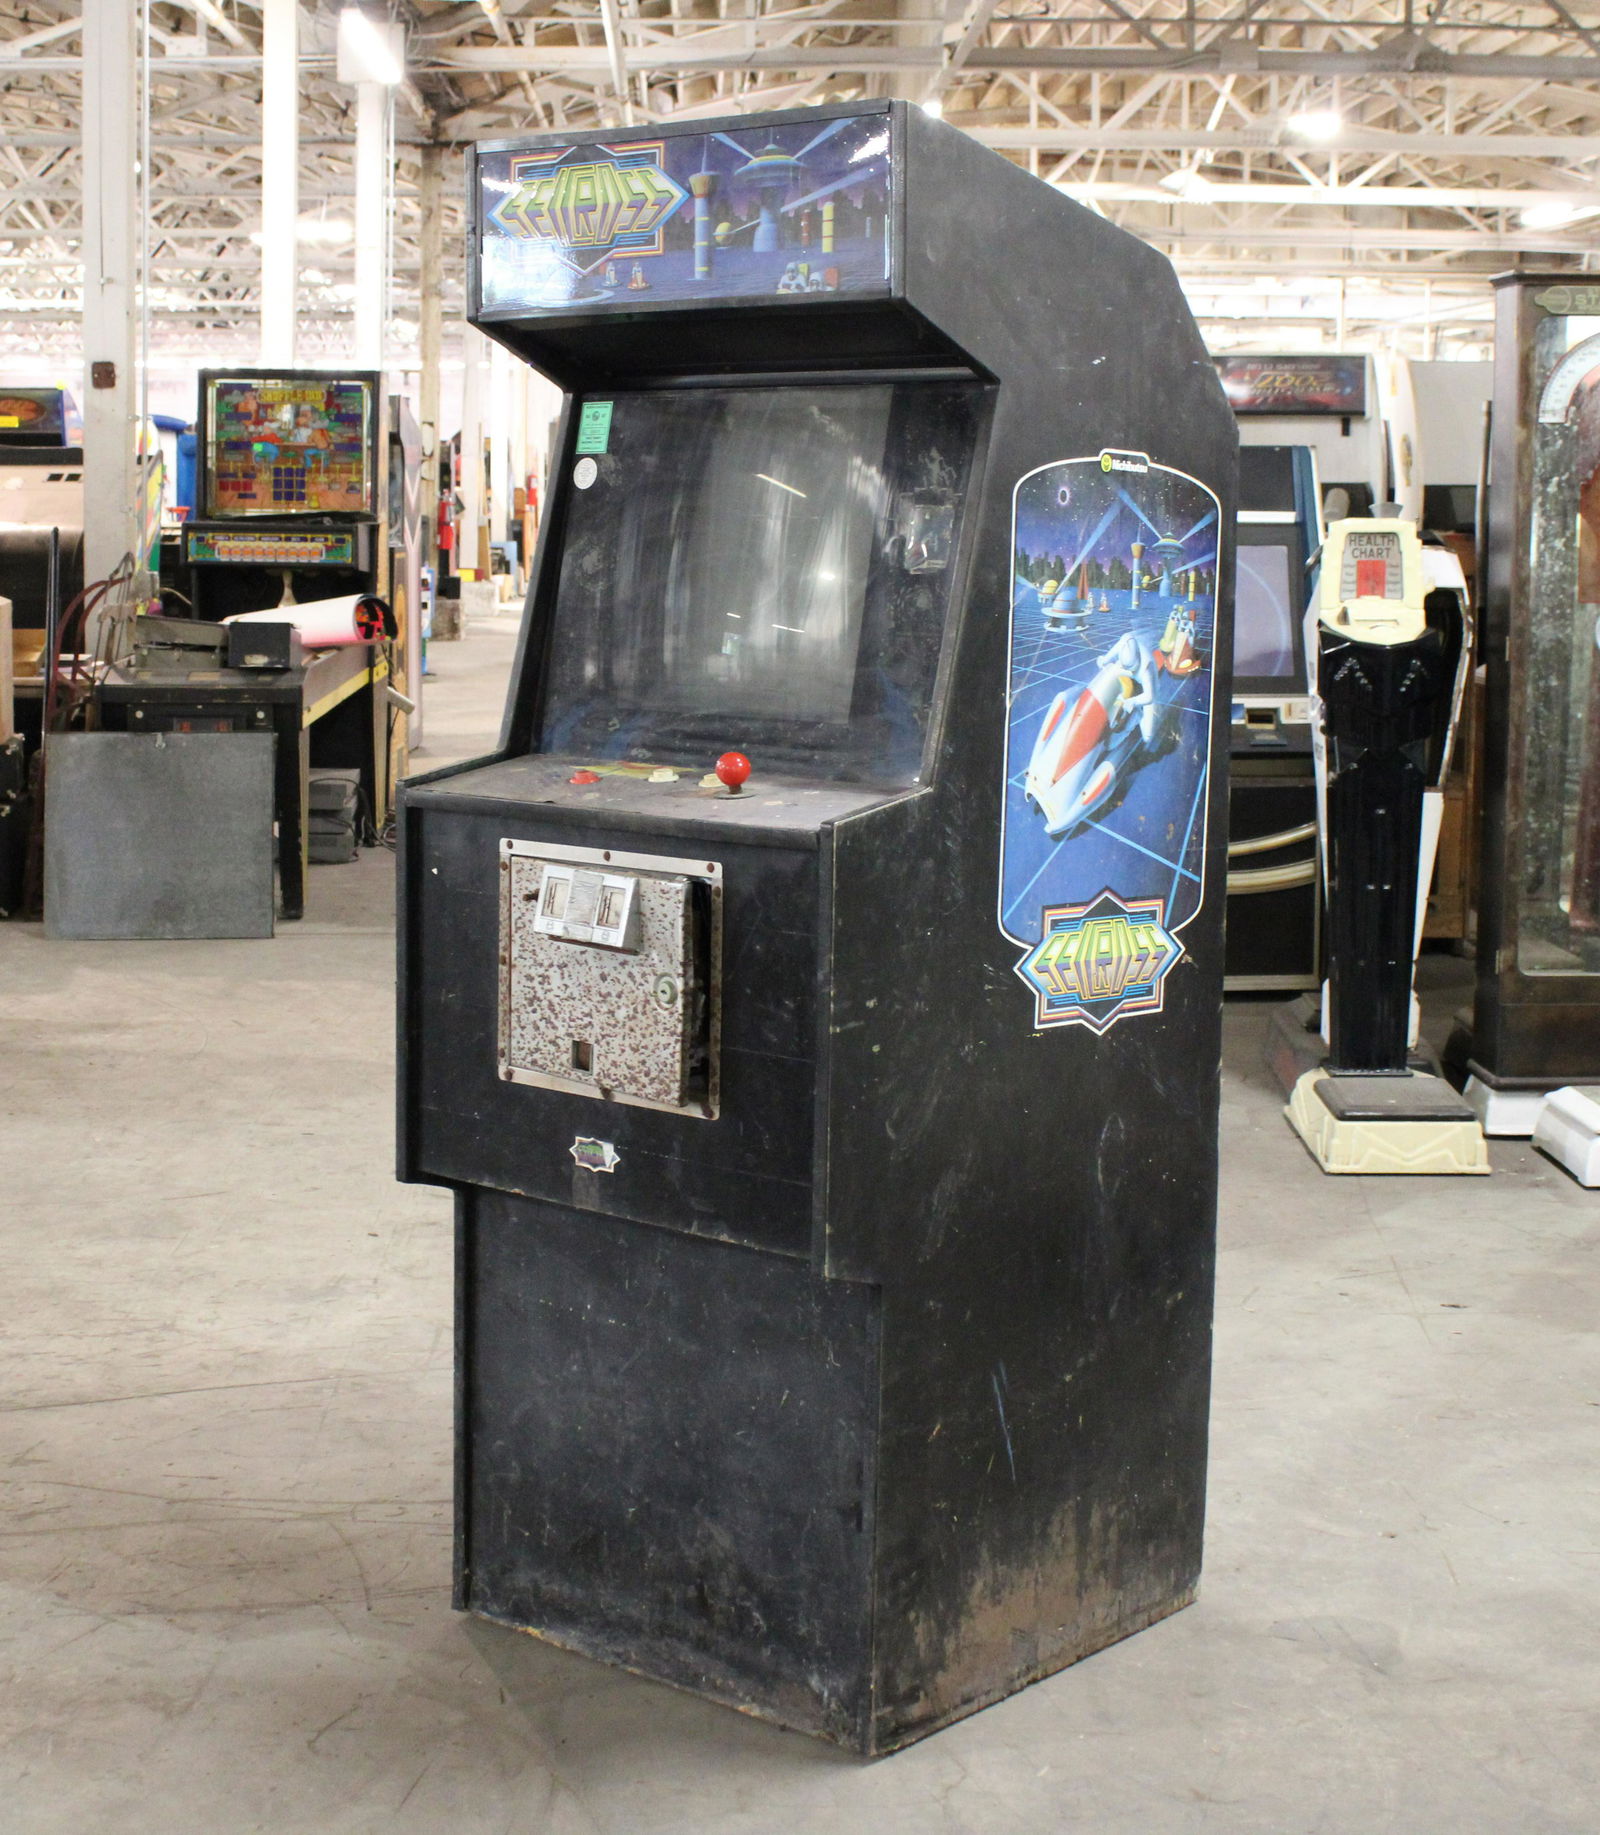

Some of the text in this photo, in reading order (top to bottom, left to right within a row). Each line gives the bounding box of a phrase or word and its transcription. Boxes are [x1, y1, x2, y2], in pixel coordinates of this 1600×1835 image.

[1575, 294, 1600, 304] ST
[1349, 535, 1395, 546] HEALTH
[1351, 547, 1391, 558] CHART
